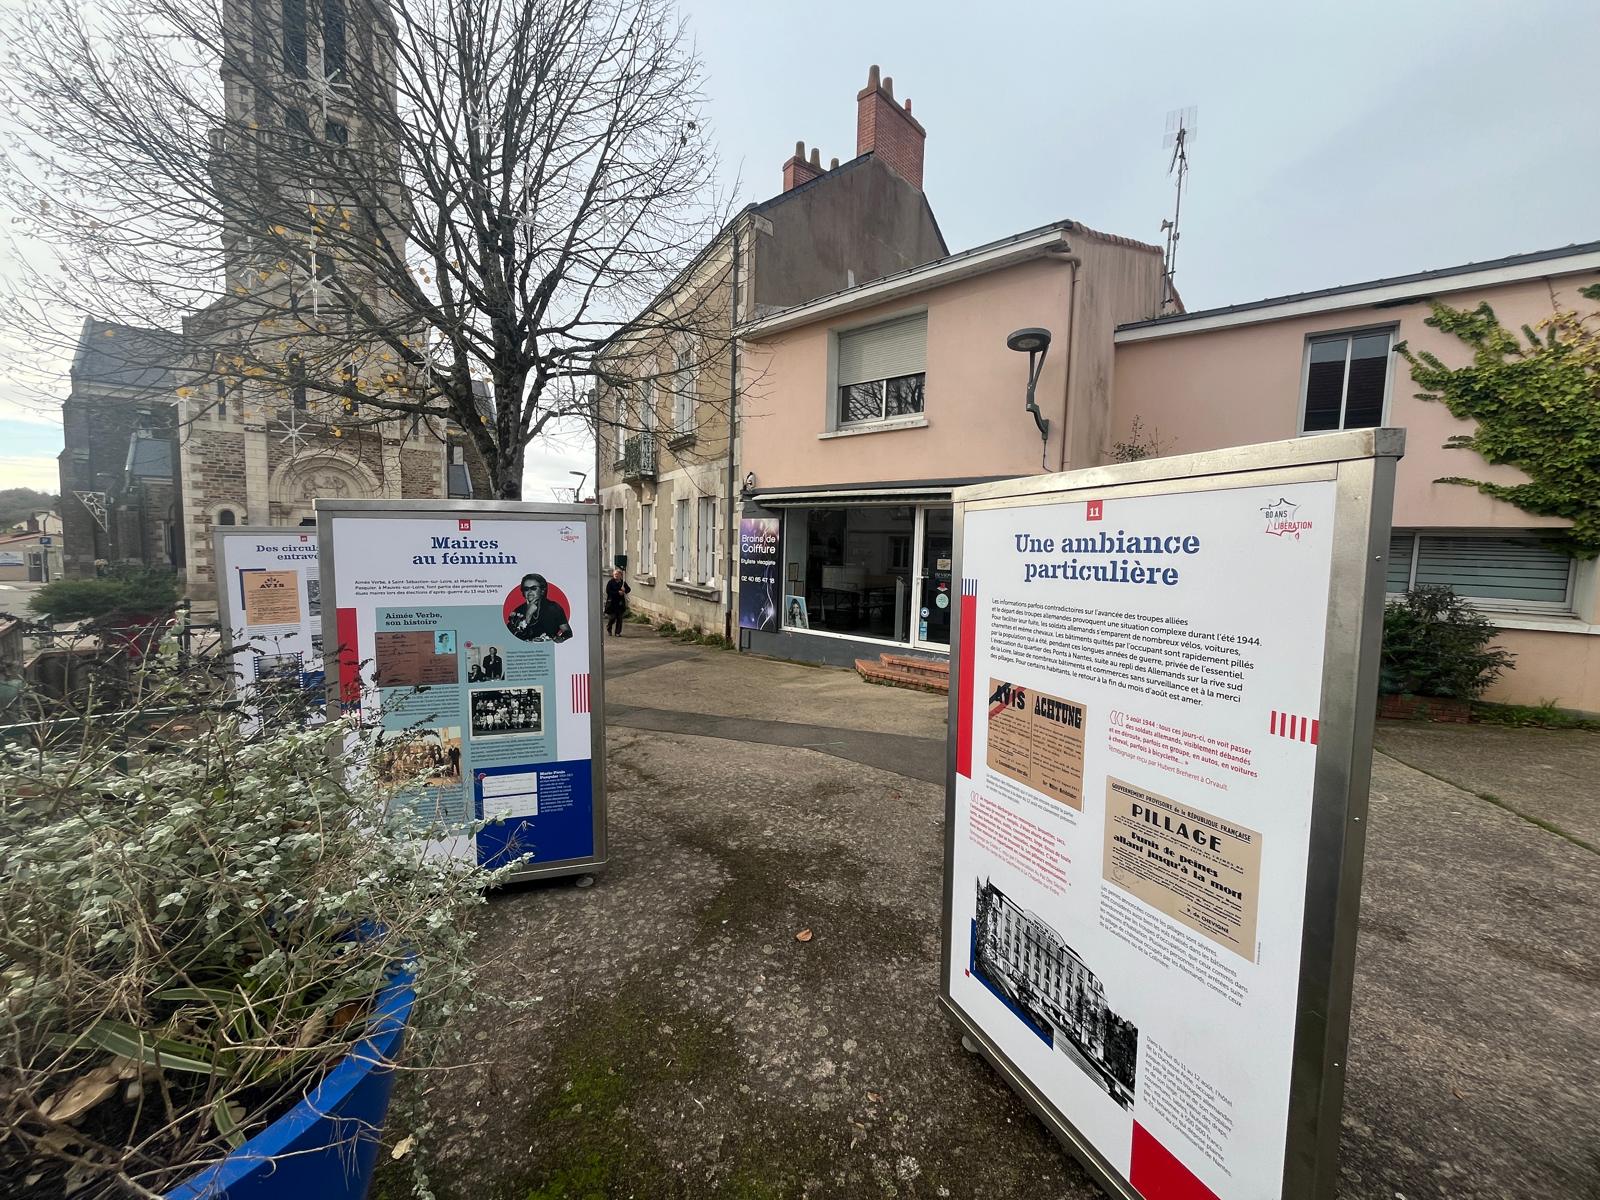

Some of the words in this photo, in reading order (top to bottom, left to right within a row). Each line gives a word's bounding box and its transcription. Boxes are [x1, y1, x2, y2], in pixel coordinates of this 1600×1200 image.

[1089, 508, 1100, 517] 11
[431, 536, 499, 549] Maires
[742, 544, 775, 553] Coiffure
[1015, 534, 1054, 553] Une
[1061, 530, 1200, 554] ambiance
[412, 555, 436, 565] au
[442, 552, 518, 565] féminin
[1024, 558, 1179, 586] particulière
[1072, 617, 1107, 626] provoquent
[1120, 621, 1150, 632] situation
[1150, 626, 1187, 636] complexe
[1187, 629, 1215, 640] durant
[1216, 632, 1236, 643] l'été
[1236, 635, 1262, 646] 1944.
[1094, 609, 1123, 618] l'avancée
[1124, 612, 1136, 620] des
[1136, 613, 1164, 624] troupes
[1165, 616, 1189, 626] alliées
[1064, 632, 1093, 643] bâtiments
[1093, 638, 1114, 647] quittés
[1126, 642, 1163, 654] l'occupant
[1163, 649, 1181, 657] sont
[1181, 652, 1230, 665] rapidement
[1230, 658, 1254, 669] pillés
[1067, 624, 1096, 634] allemands
[1096, 628, 1131, 639] s'emparent
[1132, 633, 1141, 641] de
[1141, 636, 1180, 646] nombreux
[1180, 640, 1203, 652] vélos,
[1204, 644, 1241, 657] voitures,
[1072, 652, 1093, 664] Nantes,
[1094, 657, 1109, 665] suite
[1118, 662, 1134, 671] repli
[1134, 663, 1147, 672] des
[1147, 666, 1186, 680] Allemands
[1186, 675, 1200, 683] sur
[1200, 675, 1209, 684] la
[1209, 678, 1226, 688] rive
[1226, 682, 1243, 691] sud
[1081, 644, 1105, 655] longues
[1105, 650, 1128, 659] années
[1129, 652, 1138, 661] de
[1138, 656, 1164, 667] guerre,
[1164, 660, 1189, 670] privée
[1189, 662, 1200, 672] de
[1201, 664, 1245, 680] l'essentiel.
[996, 684, 1027, 711] AVIS
[1034, 695, 1083, 729] ACHTUNG
[1132, 802, 1222, 854] PILLAGE
[1145, 795, 1173, 811] PROVISOIRE
[1220, 824, 1251, 842] FRANÇAISE
[1114, 834, 1143, 853] allant
[1147, 848, 1189, 875] jusqu'à
[1210, 880, 1242, 900] mort
[1131, 831, 1159, 851] Punis
[1179, 854, 1218, 878] peines
